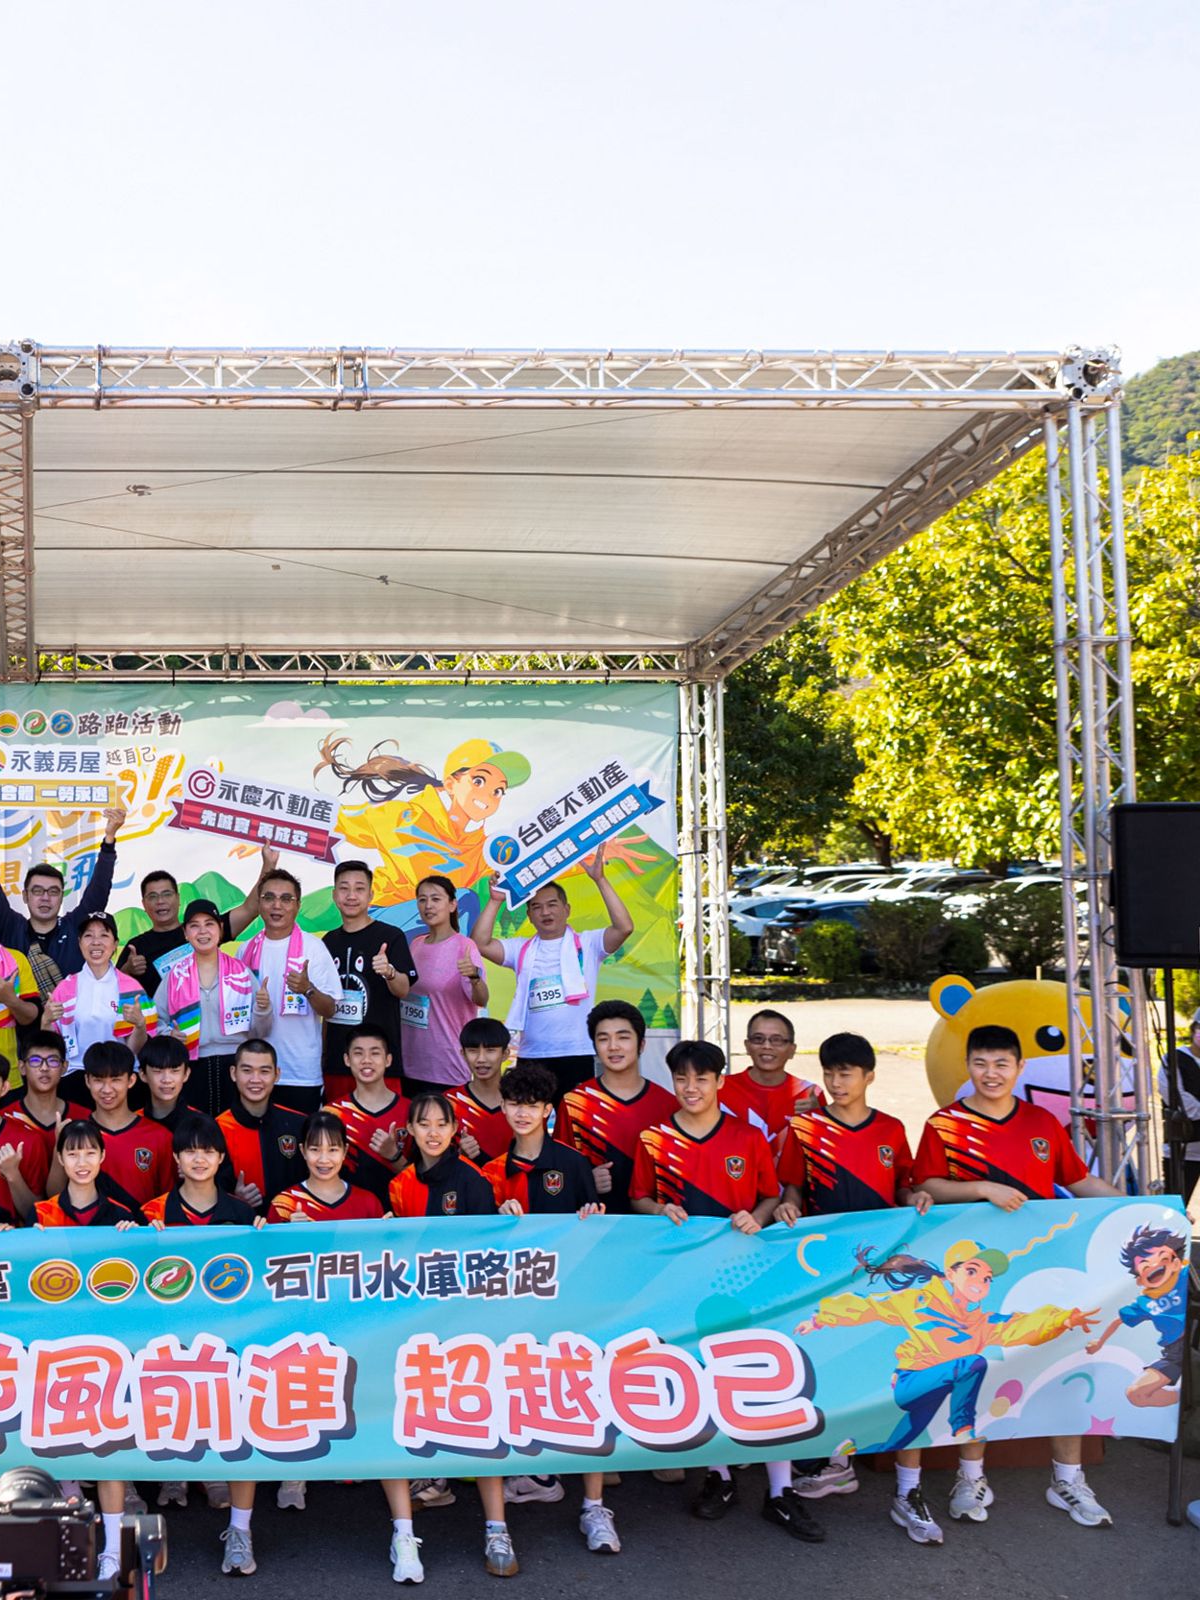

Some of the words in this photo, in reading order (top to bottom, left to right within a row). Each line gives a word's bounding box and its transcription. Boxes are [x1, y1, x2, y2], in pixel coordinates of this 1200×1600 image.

[78, 712, 182, 737] 路跑活動
[11, 750, 100, 773] 永義房屋
[217, 779, 334, 823] 永慶不動產
[518, 760, 629, 848] 台慶不動產
[536, 989, 561, 1001] 1395
[405, 1006, 424, 1019] 1950
[267, 1253, 557, 1300] 石門水庫路跑
[403, 1339, 808, 1442] 超越自己
